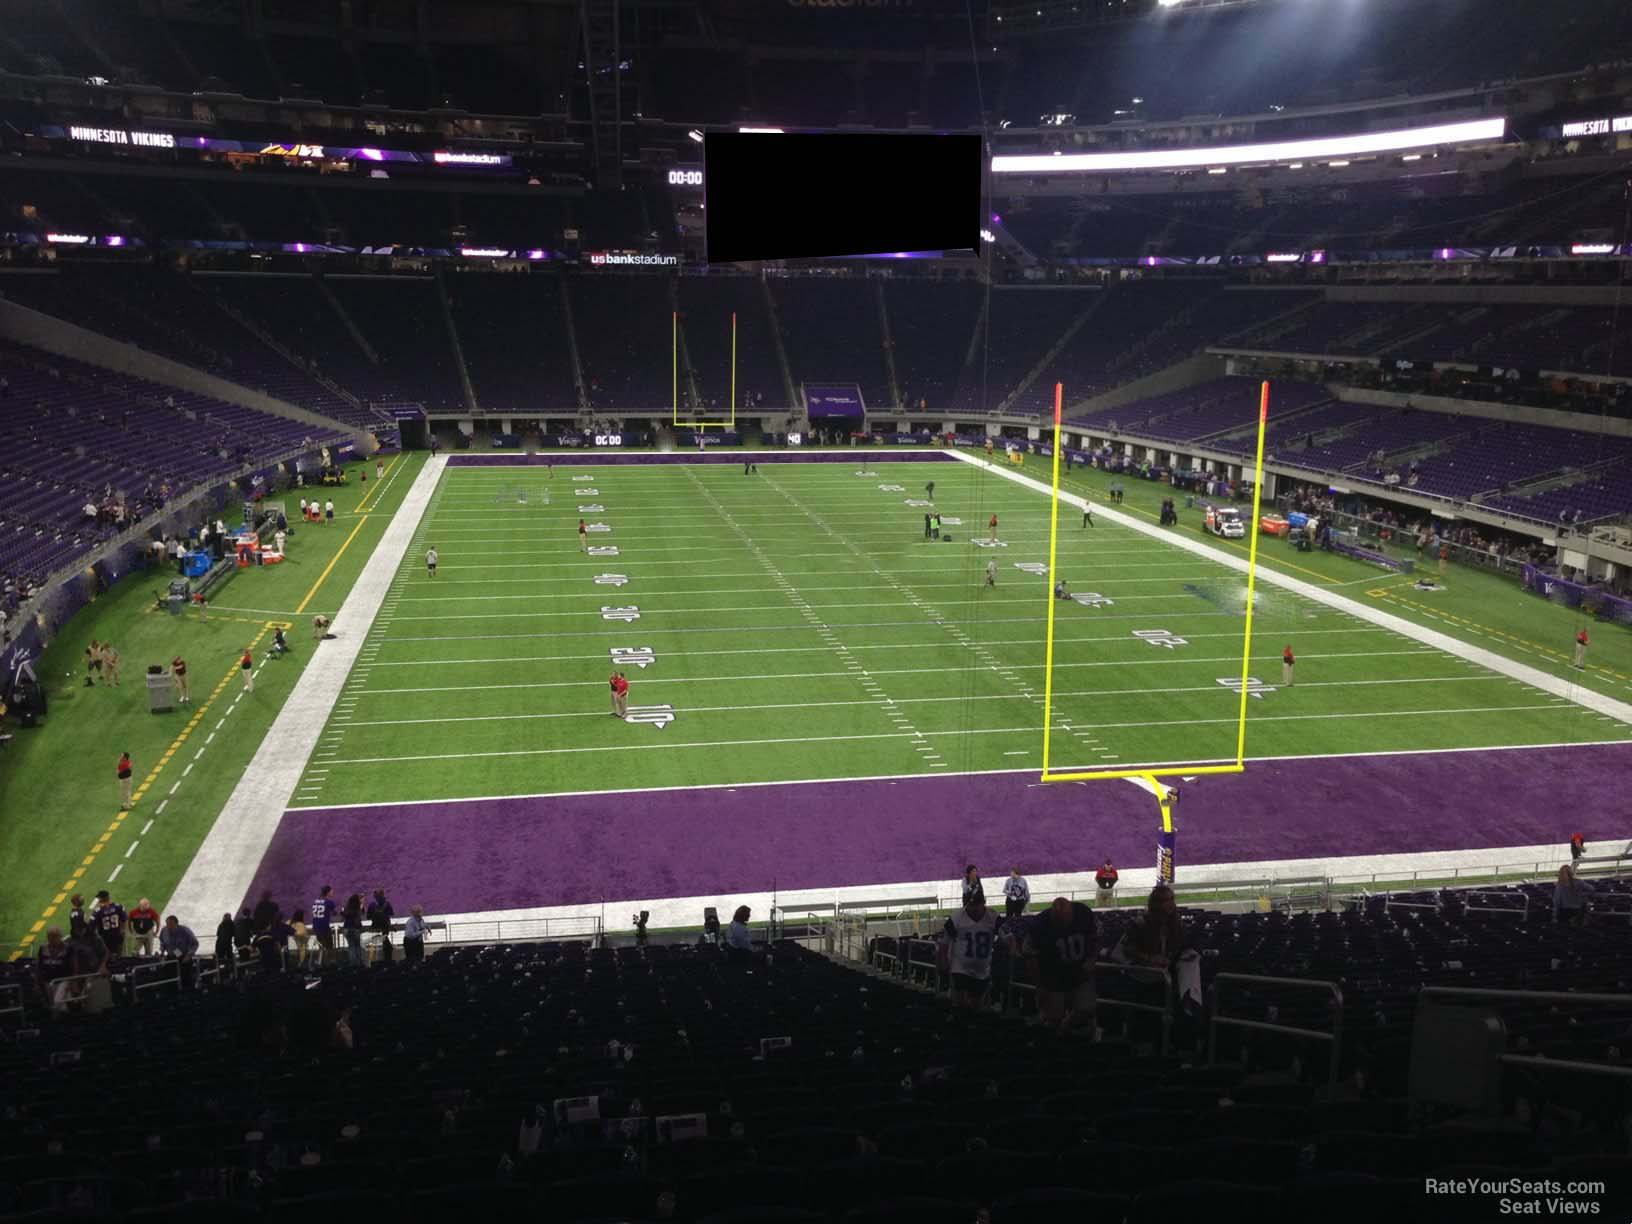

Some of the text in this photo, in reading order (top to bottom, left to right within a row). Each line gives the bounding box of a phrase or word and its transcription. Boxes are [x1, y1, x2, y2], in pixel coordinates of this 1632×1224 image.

[71, 126, 174, 148] MINNESOTA VIKINGS
[668, 171, 703, 185] 00:00
[1132, 629, 1188, 647] 20
[610, 646, 656, 664] 20
[311, 904, 326, 918] 22
[961, 930, 991, 959] 18
[1056, 933, 1086, 960] 10
